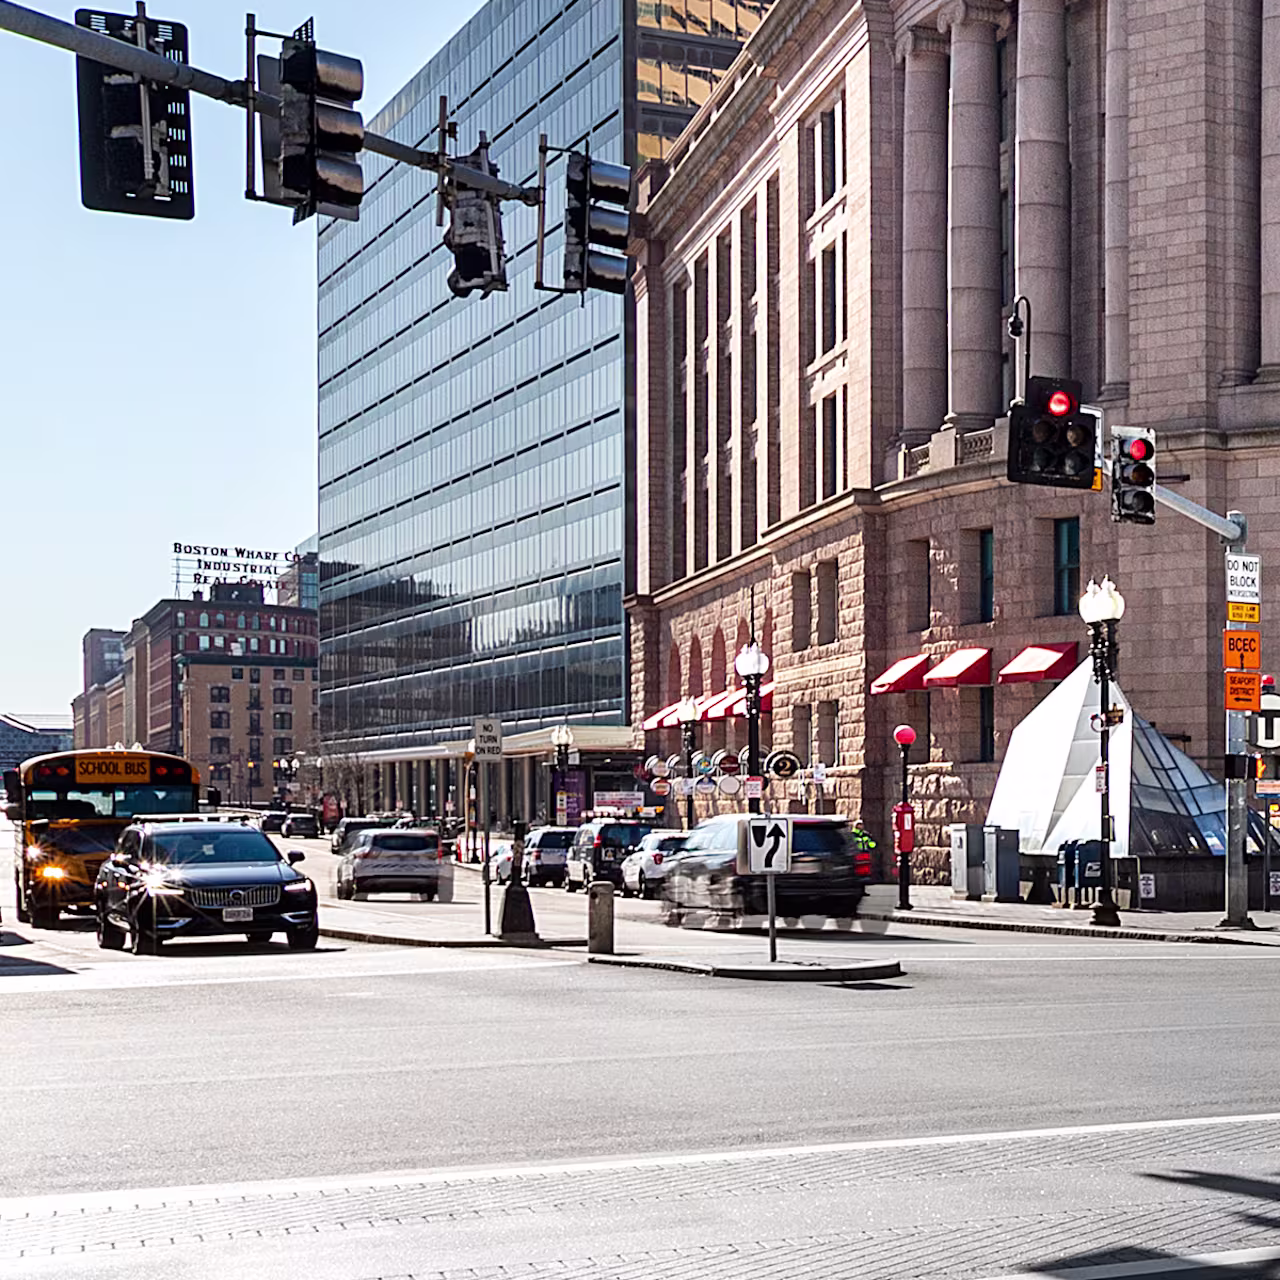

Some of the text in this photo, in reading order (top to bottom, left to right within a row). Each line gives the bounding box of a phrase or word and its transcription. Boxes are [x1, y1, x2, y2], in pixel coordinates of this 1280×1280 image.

[173, 542, 228, 557] BOSTON
[234, 547, 279, 561] WHARF
[197, 558, 280, 575] INDUSTRIAL
[1227, 560, 1259, 572] DO NOT
[1230, 575, 1257, 588] BLOCK
[1228, 637, 1257, 652] BCEC
[1230, 676, 1256, 686] SEAPORT
[1230, 687, 1255, 696] DISTRICT
[482, 724, 493, 732] NO
[479, 735, 497, 743] TURN
[476, 746, 501, 755] ON RED
[79, 761, 147, 775] SCHOOL BUS
[778, 761, 792, 776] 2
